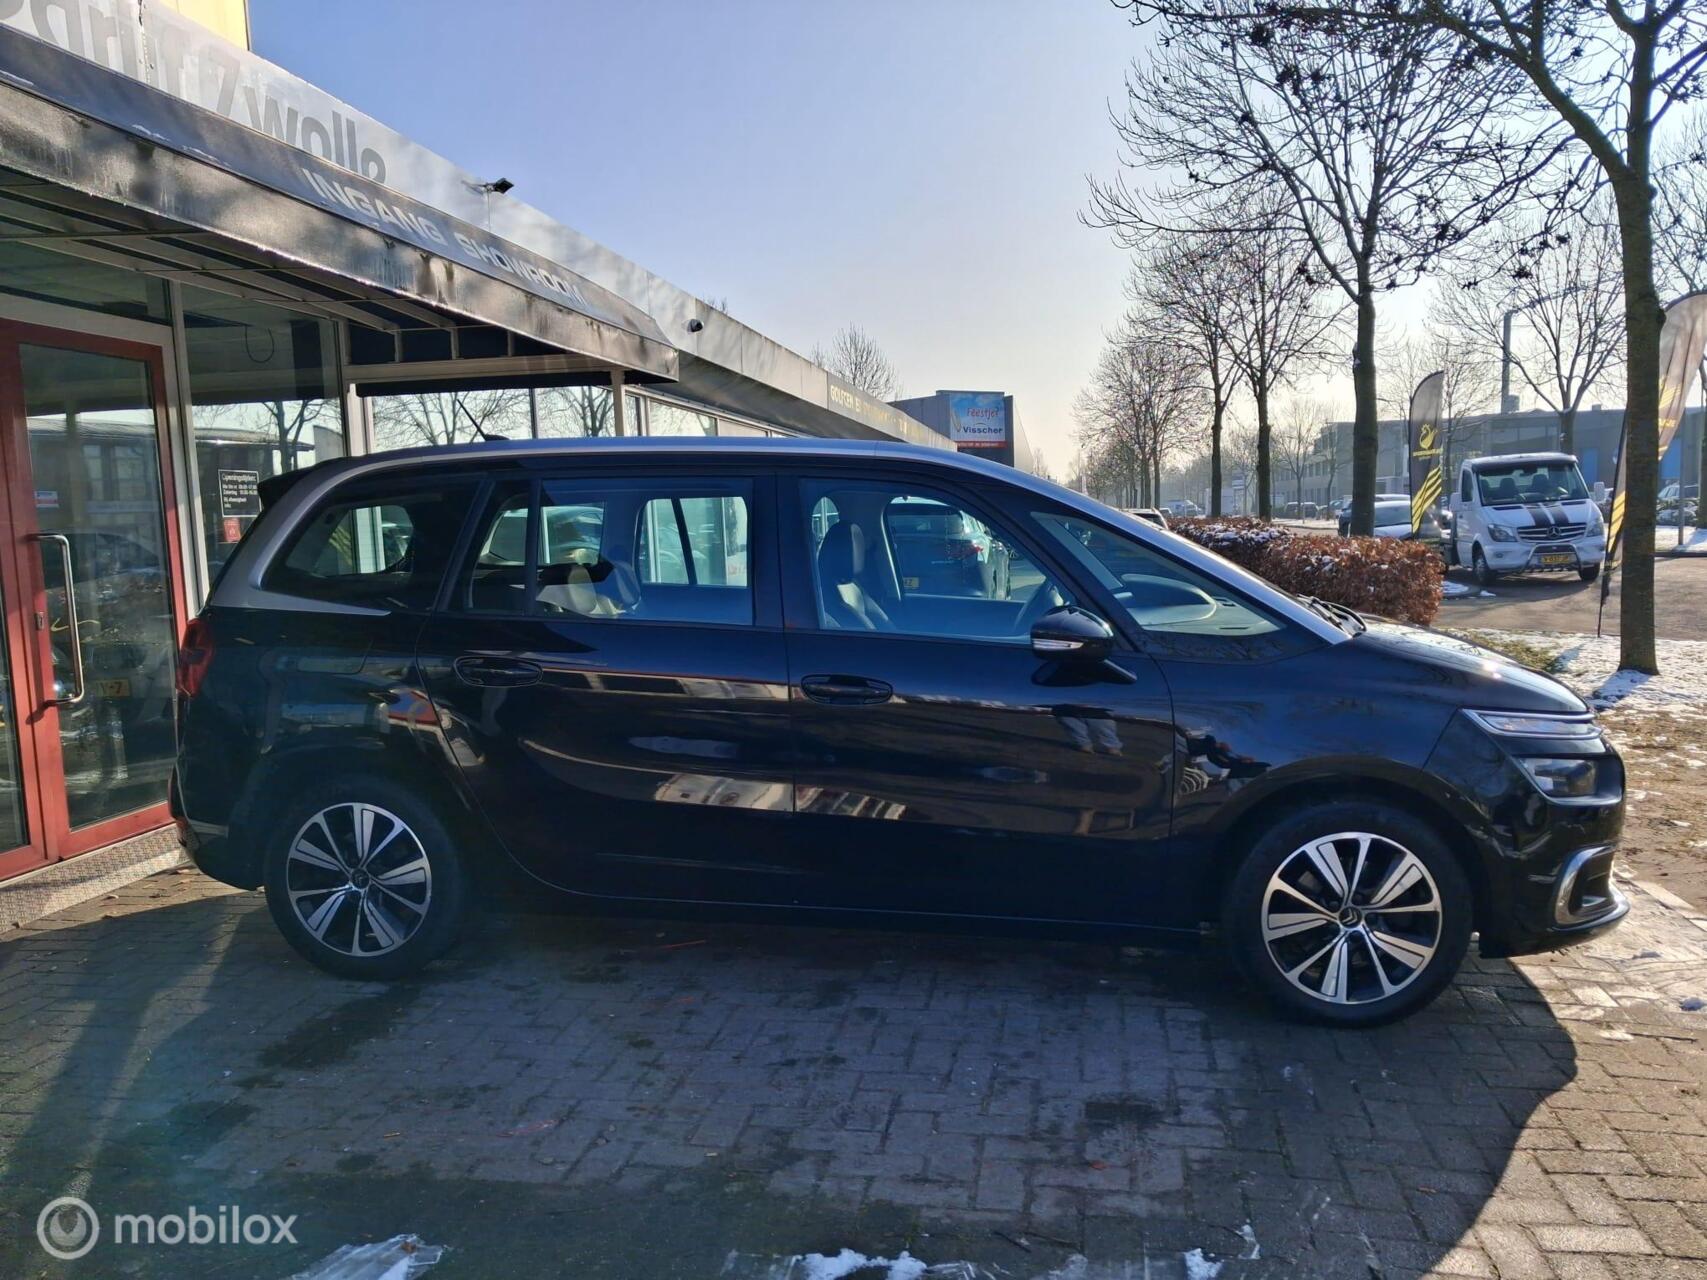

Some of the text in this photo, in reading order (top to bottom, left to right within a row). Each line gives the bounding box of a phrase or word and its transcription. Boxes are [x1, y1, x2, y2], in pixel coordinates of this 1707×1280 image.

[302, 168, 588, 306] INGANG SHOWROOM
[963, 426, 1003, 434] Visscher
